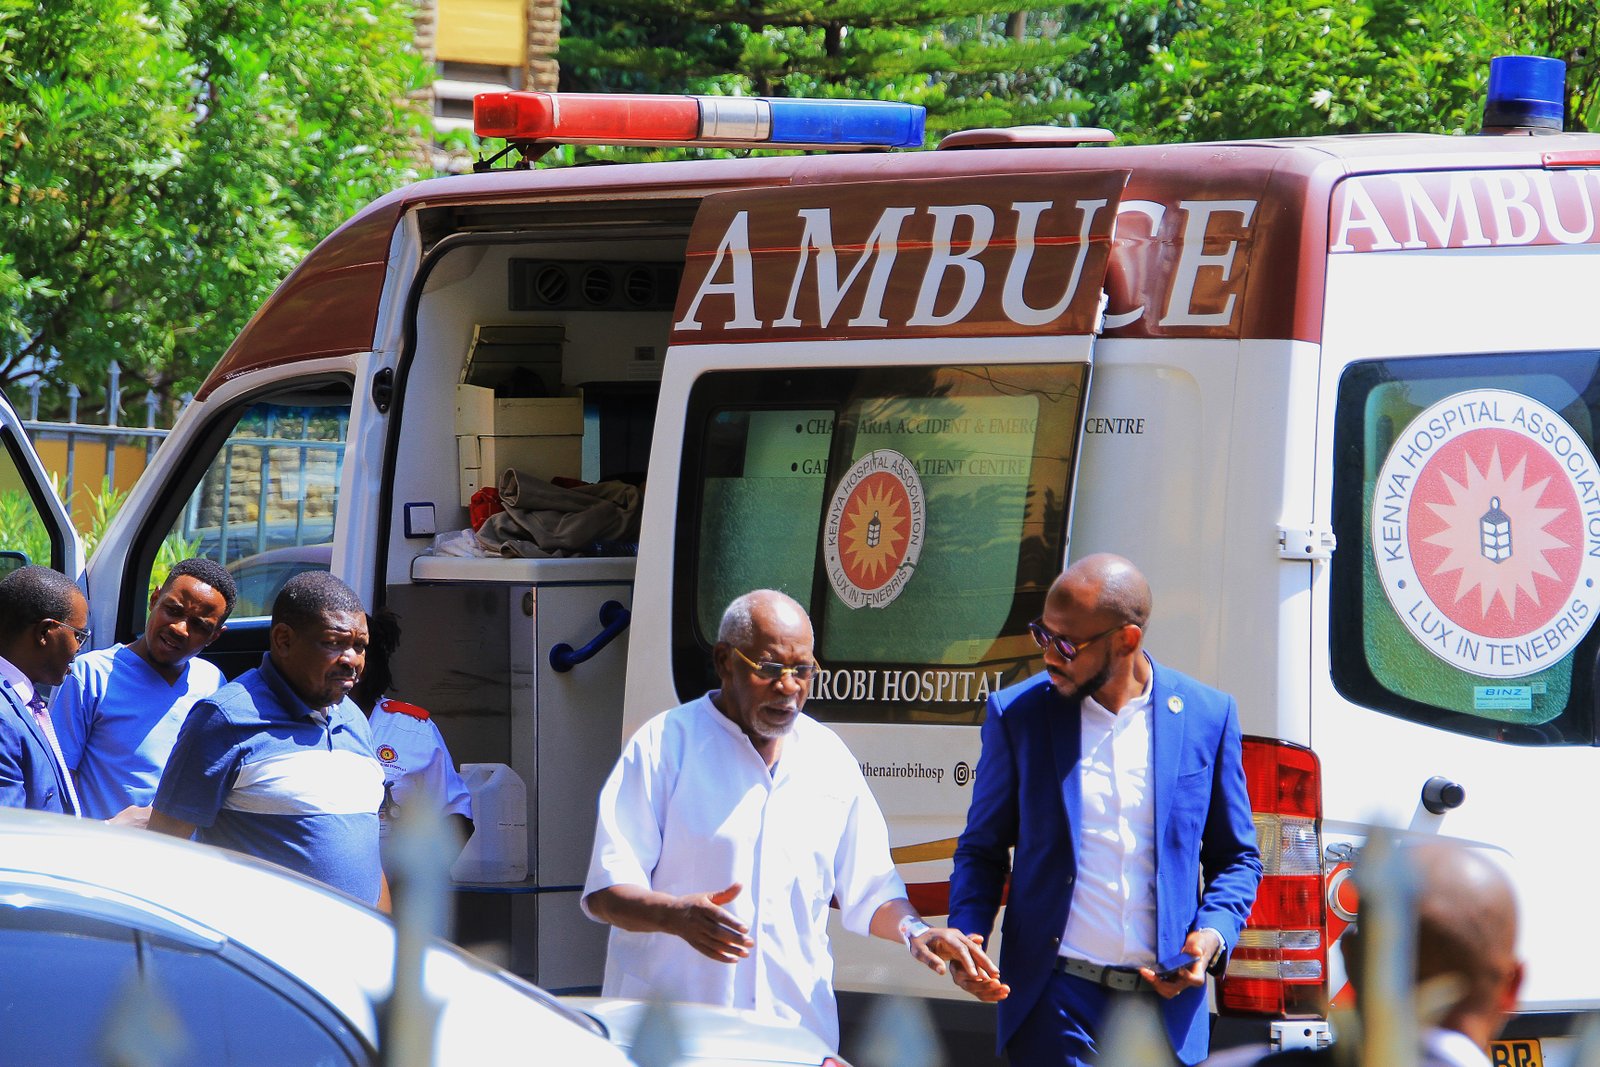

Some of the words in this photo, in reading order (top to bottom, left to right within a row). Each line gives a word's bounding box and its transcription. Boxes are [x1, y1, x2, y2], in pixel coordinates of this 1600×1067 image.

[1330, 170, 1600, 252] AMBU
[896, 417, 972, 434] ACCIDENT
[1085, 417, 1146, 435] CENTRE
[912, 458, 966, 475] ATIENT
[969, 459, 1026, 475] CENTRE
[1382, 473, 1410, 563] KENYA
[1401, 401, 1506, 469] HOSPITAL
[1511, 406, 1600, 558] ASSOCIATION
[828, 496, 846, 546] KENYA
[843, 456, 889, 494] HOSPITAL
[890, 459, 921, 546] ASSOCIATION
[832, 568, 850, 595] LUX
[848, 587, 859, 603] IN
[860, 570, 908, 605] TENEBRIS
[1408, 600, 1454, 649] LUX
[1456, 635, 1479, 662] IN
[1486, 599, 1589, 666] TENEBRIS
[806, 669, 877, 700] IROBI
[1485, 688, 1523, 696] BINZ
[859, 762, 944, 783] thenairobihosp
